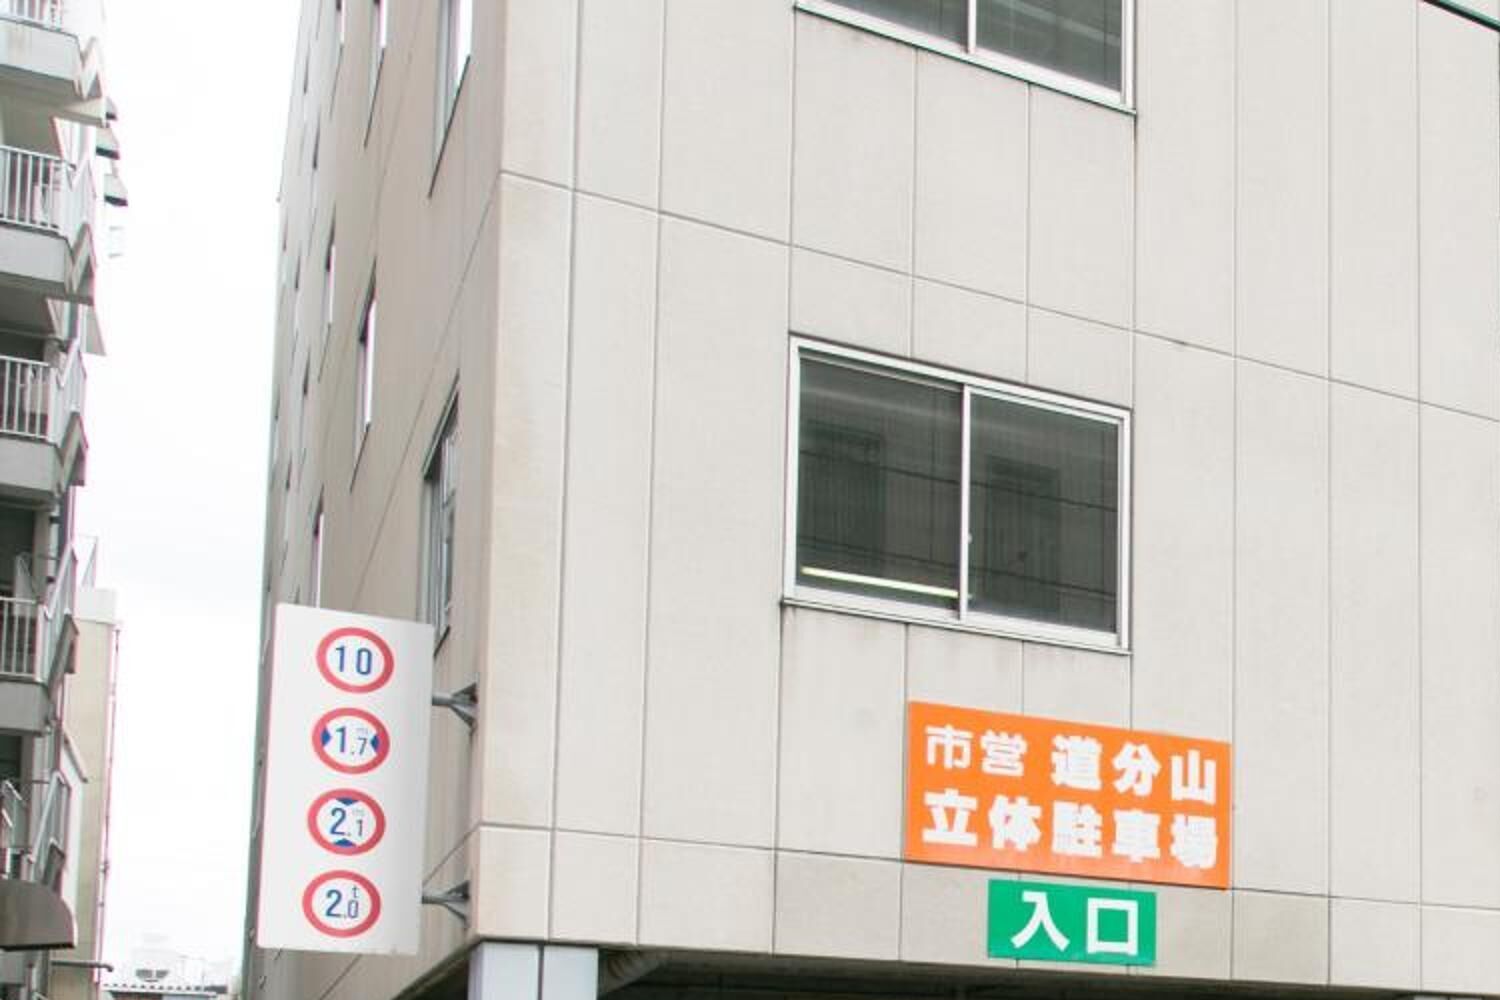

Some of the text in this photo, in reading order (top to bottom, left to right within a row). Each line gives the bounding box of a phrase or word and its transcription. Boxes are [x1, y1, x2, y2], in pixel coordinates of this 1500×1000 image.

[334, 644, 373, 676] 10
[922, 789, 1219, 869] 立体駐車場
[1010, 890, 1141, 956] 入口
